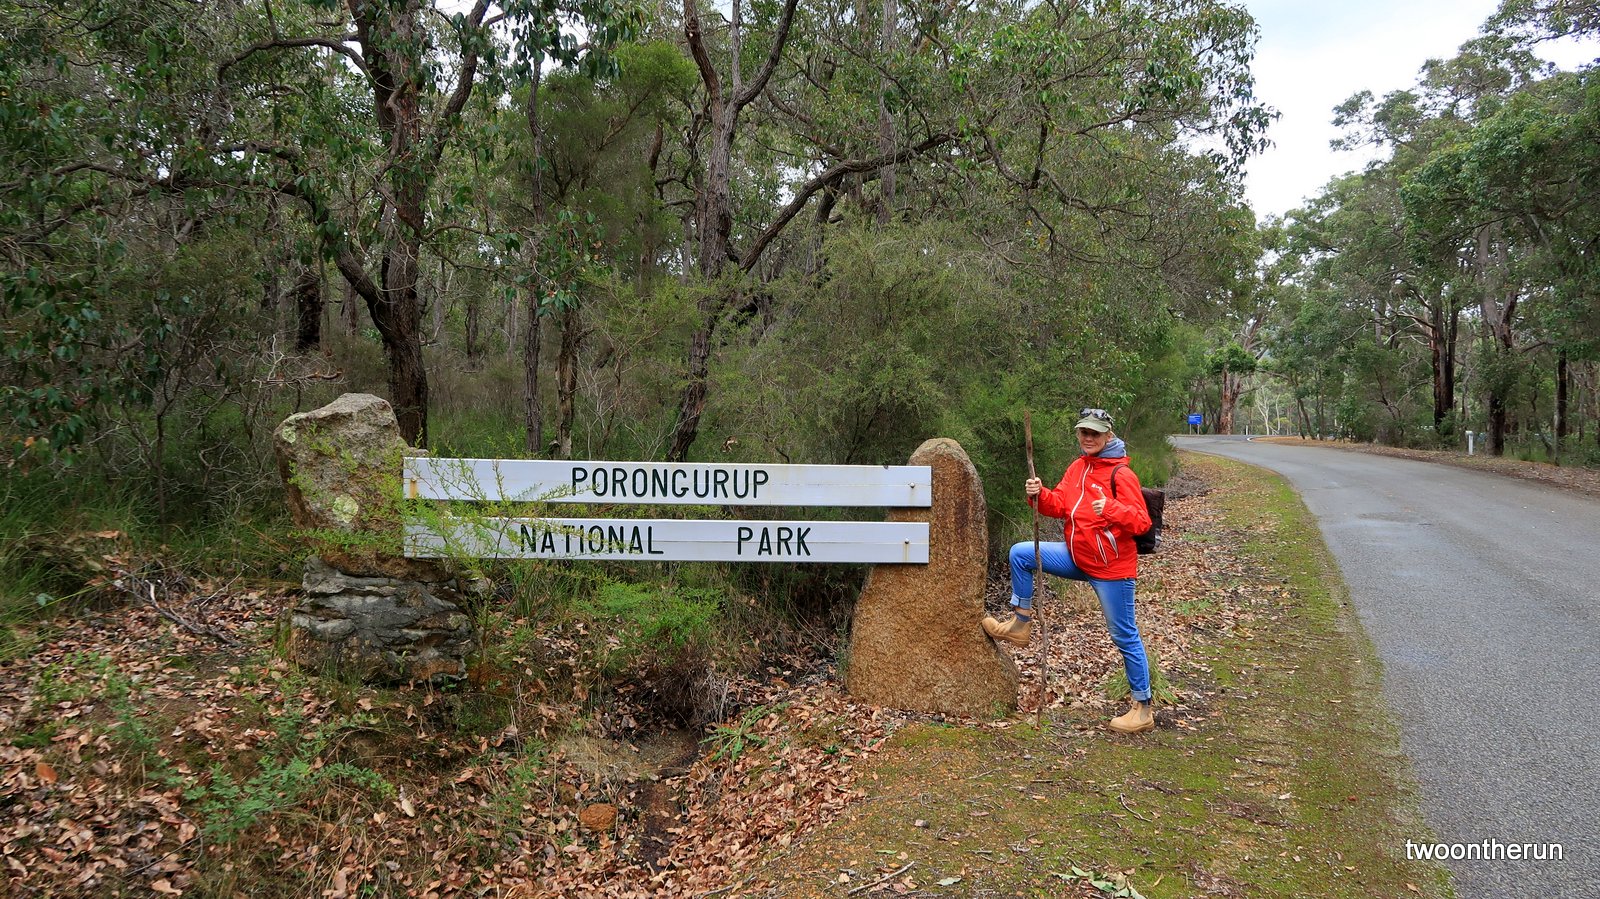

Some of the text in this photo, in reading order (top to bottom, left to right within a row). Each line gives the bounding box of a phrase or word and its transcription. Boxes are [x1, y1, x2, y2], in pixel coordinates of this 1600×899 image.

[571, 467, 769, 499] PORONGURUP
[520, 524, 811, 556] NATIONAL PARK
